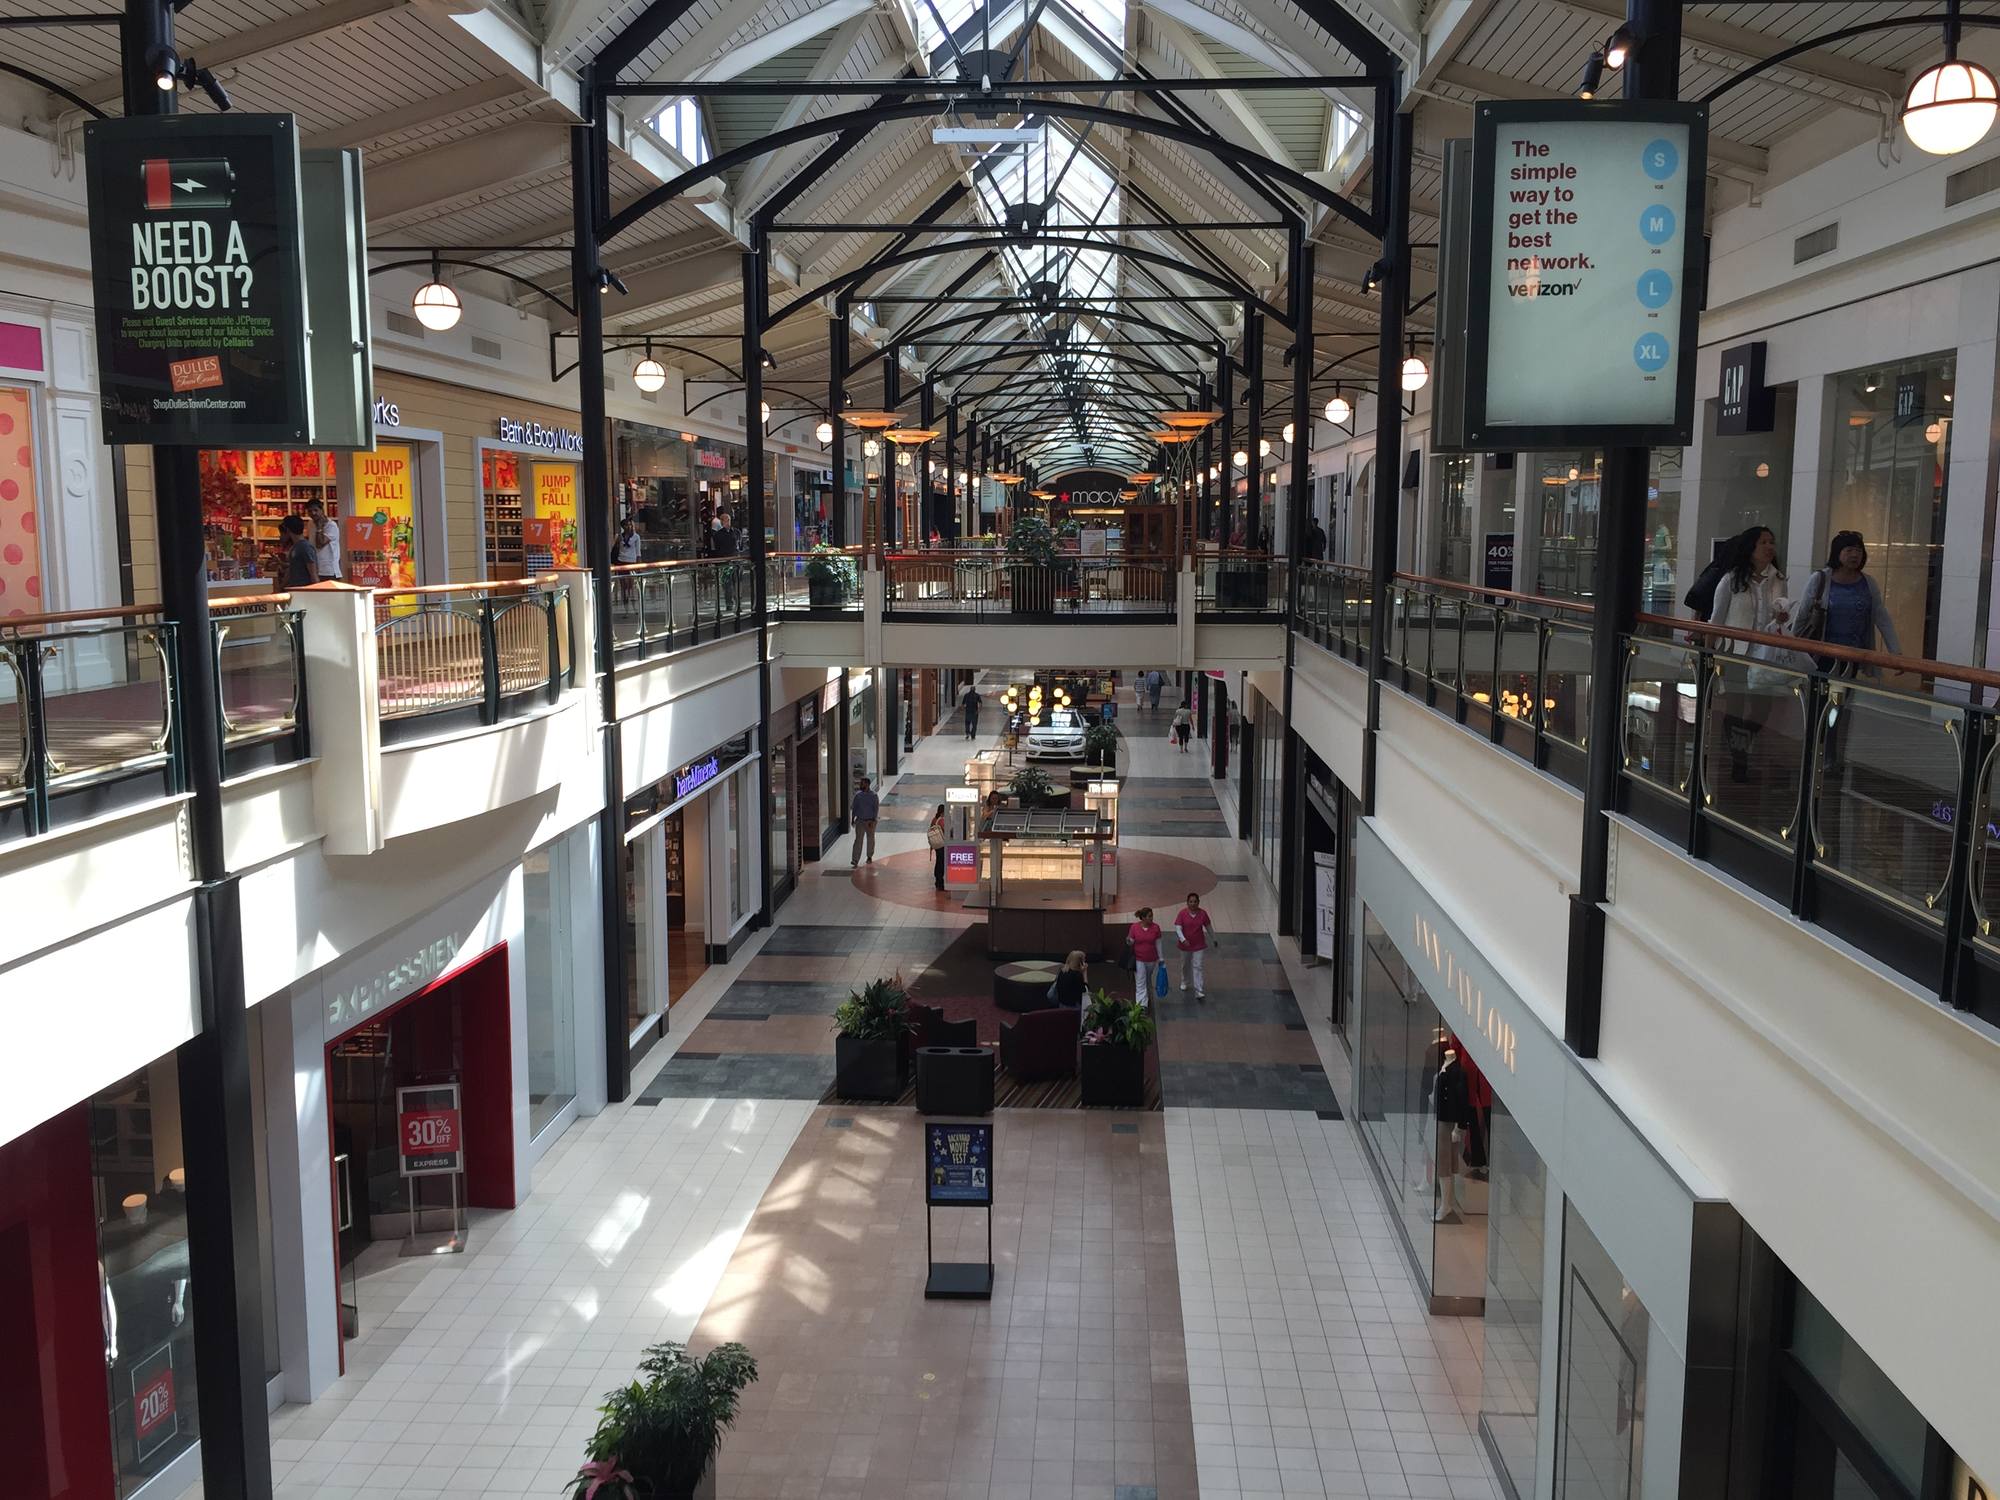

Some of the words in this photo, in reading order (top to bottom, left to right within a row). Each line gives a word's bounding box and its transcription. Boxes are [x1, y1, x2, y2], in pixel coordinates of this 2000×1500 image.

[1511, 140, 1550, 158] The
[1653, 152, 1666, 168] S
[1510, 162, 1577, 183] simple
[1509, 189, 1550, 206] way
[1554, 185, 1574, 202] to
[1508, 209, 1541, 230] get
[1545, 207, 1578, 225] the
[1649, 217, 1664, 232] M
[132, 220, 213, 266] NEED
[224, 219, 249, 264] A
[1508, 231, 1552, 248] best
[1507, 252, 1595, 271] network.
[131, 264, 254, 310] BOOST?
[1507, 281, 1574, 297] verizon
[1649, 281, 1659, 296] L
[155, 316, 175, 326] Guest
[176, 315, 208, 326] Services
[209, 315, 234, 326] outside
[235, 315, 271, 326] JCPenney
[150, 327, 167, 337] about
[191, 328, 204, 337] one
[205, 327, 214, 336] of
[214, 328, 226, 337] our
[227, 326, 250, 337] Mobile
[251, 326, 275, 337] Device
[183, 337, 212, 348] provided
[213, 338, 223, 348] by
[1639, 345, 1661, 360] XL
[173, 359, 217, 376] DULLES
[1724, 365, 1744, 405] GAP
[153, 398, 246, 410] ShopDullesTownCenter.com
[500, 417, 525, 444] Bath
[525, 421, 534, 446] &
[533, 422, 559, 454] Body
[363, 458, 404, 476] JUMP
[375, 475, 391, 483] INTO
[541, 474, 571, 488] JUMP
[364, 482, 403, 500] FALL!
[541, 493, 570, 506] FALL!
[355, 522, 373, 540] $7
[676, 756, 719, 799] bareMinerals
[950, 852, 974, 862] FREE
[1444, 949, 1516, 1075] TAYLOR
[408, 1119, 451, 1146] 30%
[436, 1134, 451, 1144] OFF
[949, 1142, 970, 1153] MOVIE
[413, 1159, 449, 1168] EXPRESS
[140, 1383, 169, 1427] 20%
[159, 1398, 169, 1413] OFF
